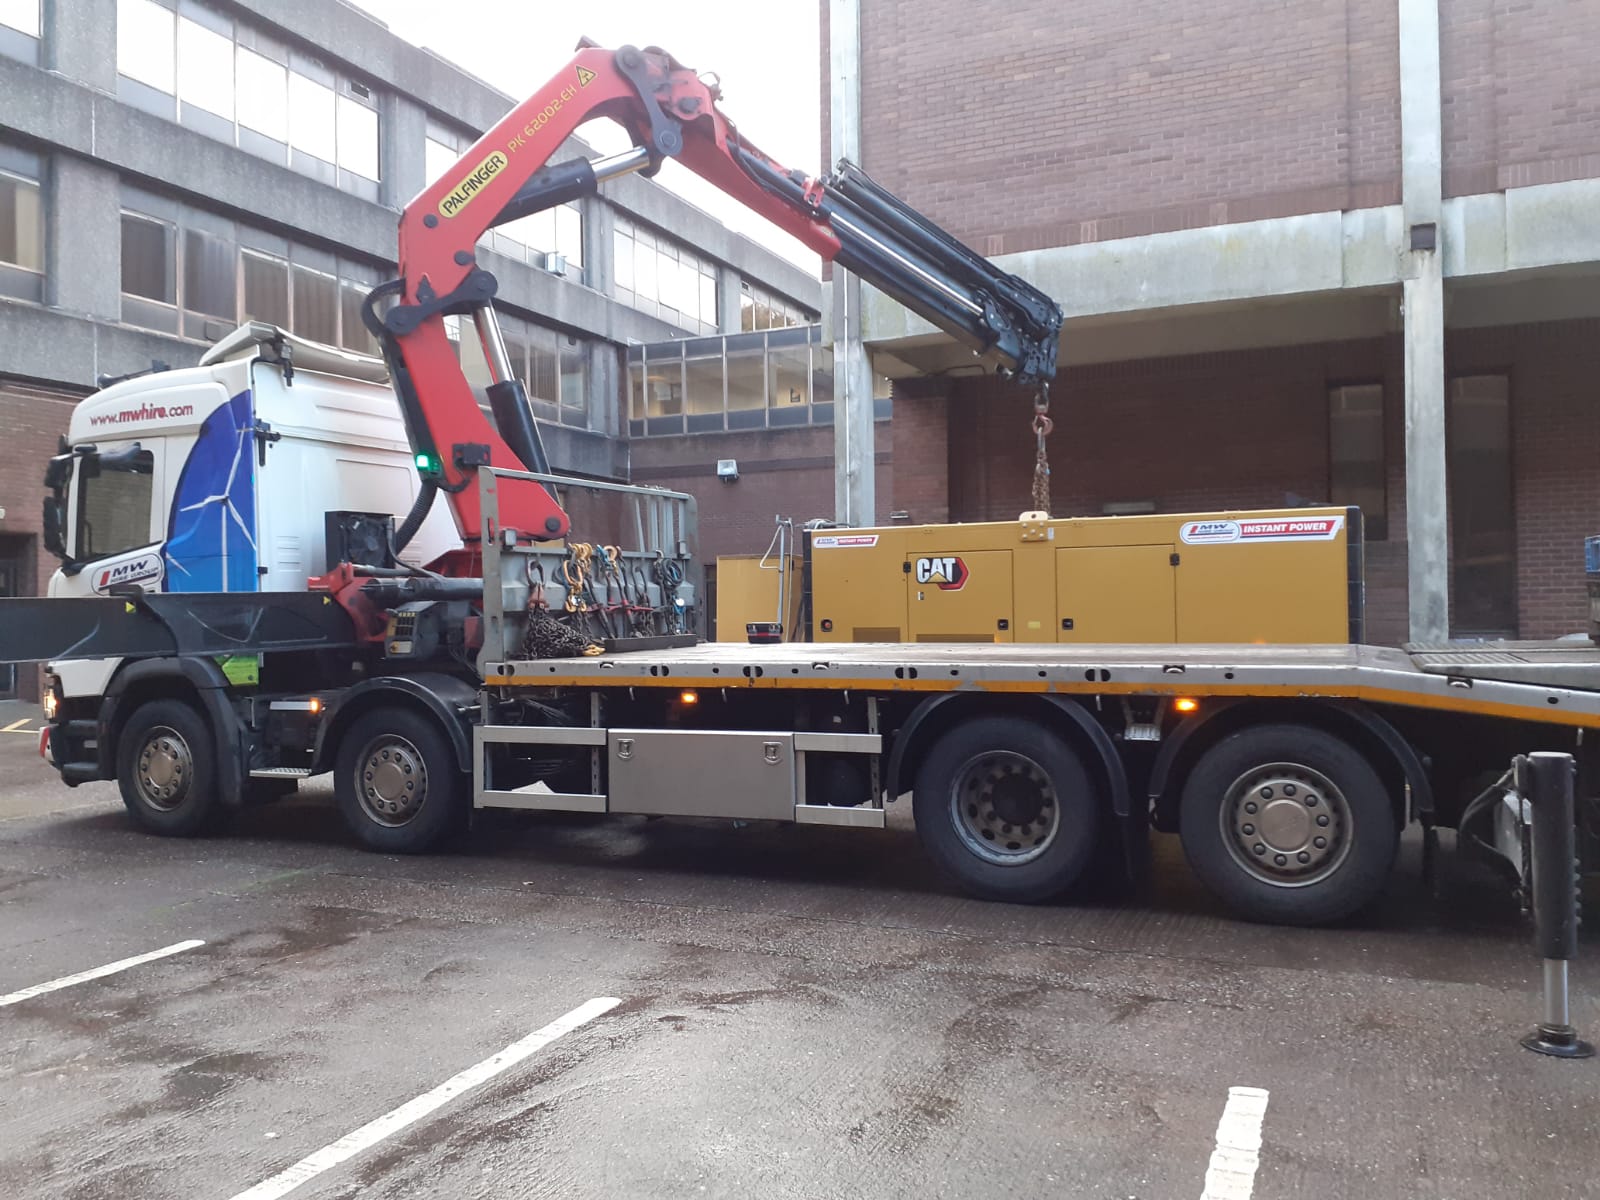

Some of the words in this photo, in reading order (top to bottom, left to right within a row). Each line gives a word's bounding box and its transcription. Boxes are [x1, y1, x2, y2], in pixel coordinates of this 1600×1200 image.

[507, 133, 527, 154] PK
[442, 155, 505, 214] PALFINGER
[90, 402, 193, 426] www.mwhire.com
[1199, 523, 1228, 531] MW
[1243, 524, 1287, 534] INSTANT
[1289, 522, 1327, 532] POWER
[112, 560, 148, 577] MW
[916, 558, 956, 584] CAT
